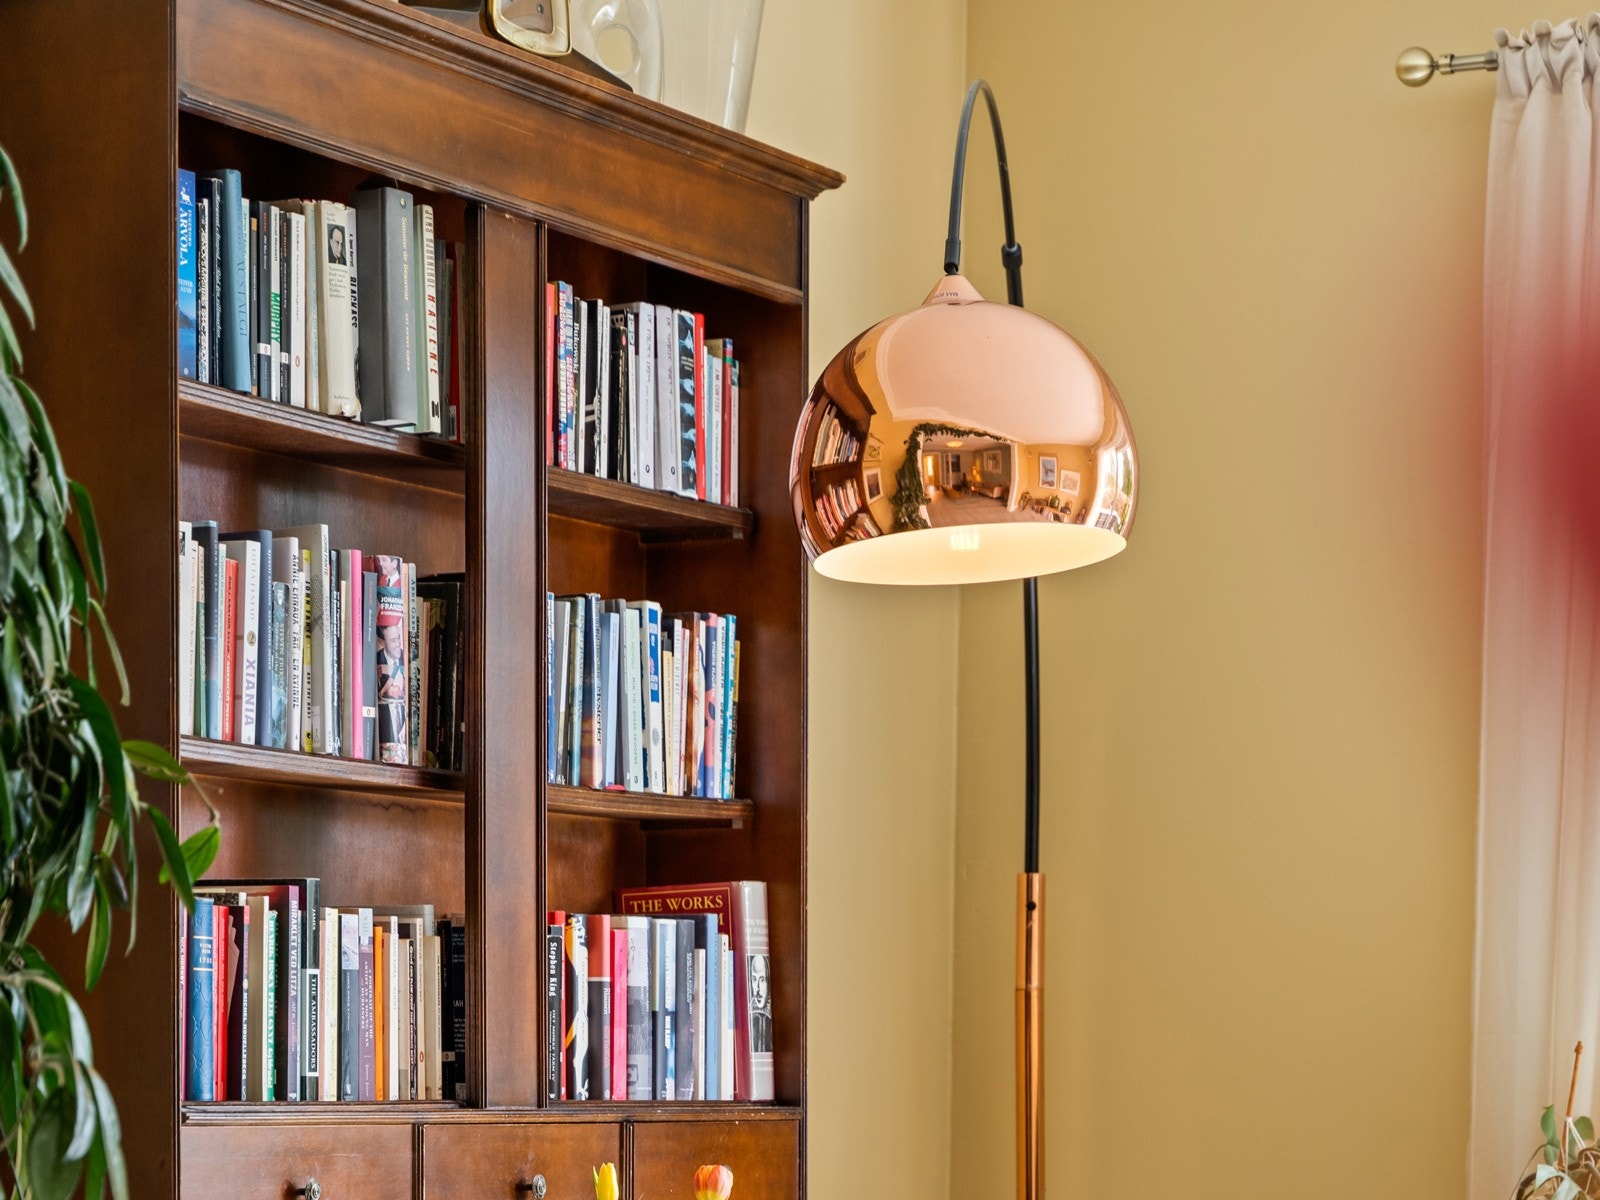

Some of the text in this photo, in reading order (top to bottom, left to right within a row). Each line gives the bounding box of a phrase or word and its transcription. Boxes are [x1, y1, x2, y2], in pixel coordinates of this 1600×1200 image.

[180, 208, 188, 266] ARVOLA
[271, 291, 280, 344] MURPHY
[244, 658, 256, 727] XIANIA
[630, 894, 723, 914] THE WORKS
[549, 942, 558, 975] Stephen
[549, 977, 558, 997] King
